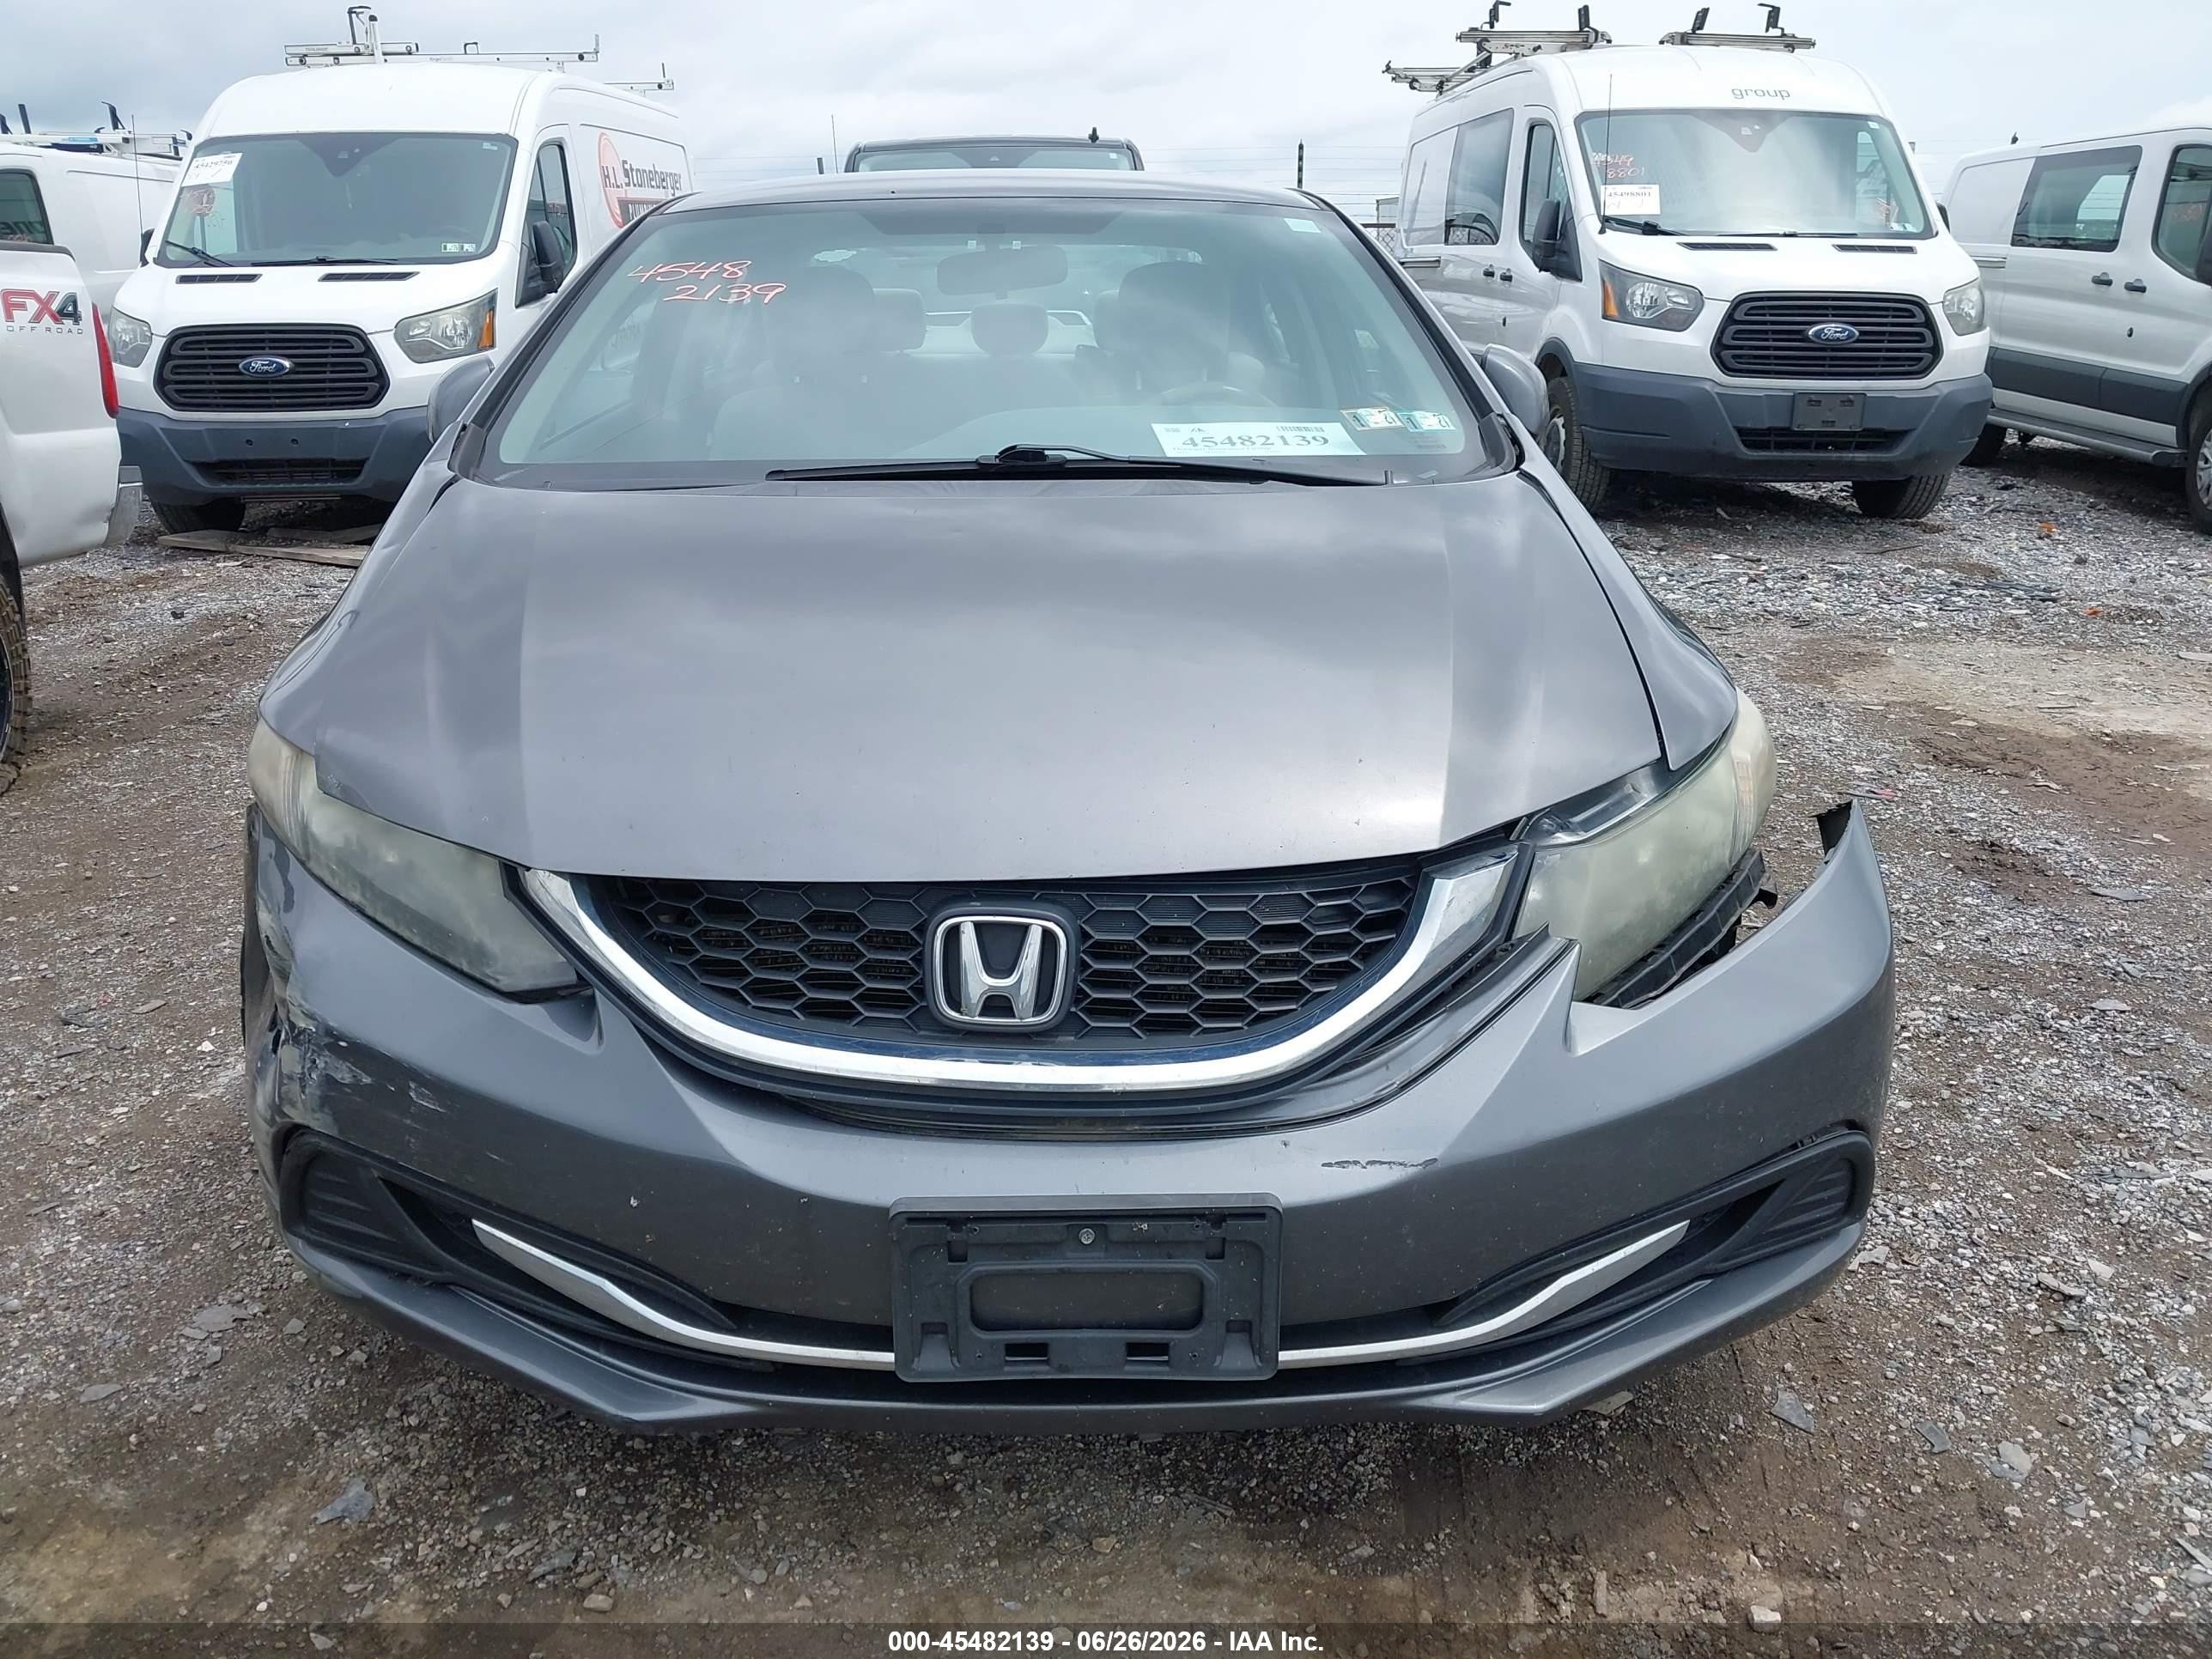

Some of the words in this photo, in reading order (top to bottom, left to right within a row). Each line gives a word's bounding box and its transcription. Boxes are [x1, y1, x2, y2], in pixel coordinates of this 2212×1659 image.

[1731, 88, 1790, 100] group
[602, 165, 623, 189] H.L.
[622, 159, 683, 197] Stoneberger
[626, 259, 752, 283] 4548
[662, 282, 787, 304] 2139
[0, 289, 82, 325] FX4
[46, 326, 83, 335] ROAD
[1182, 434, 1330, 447] 45482139
